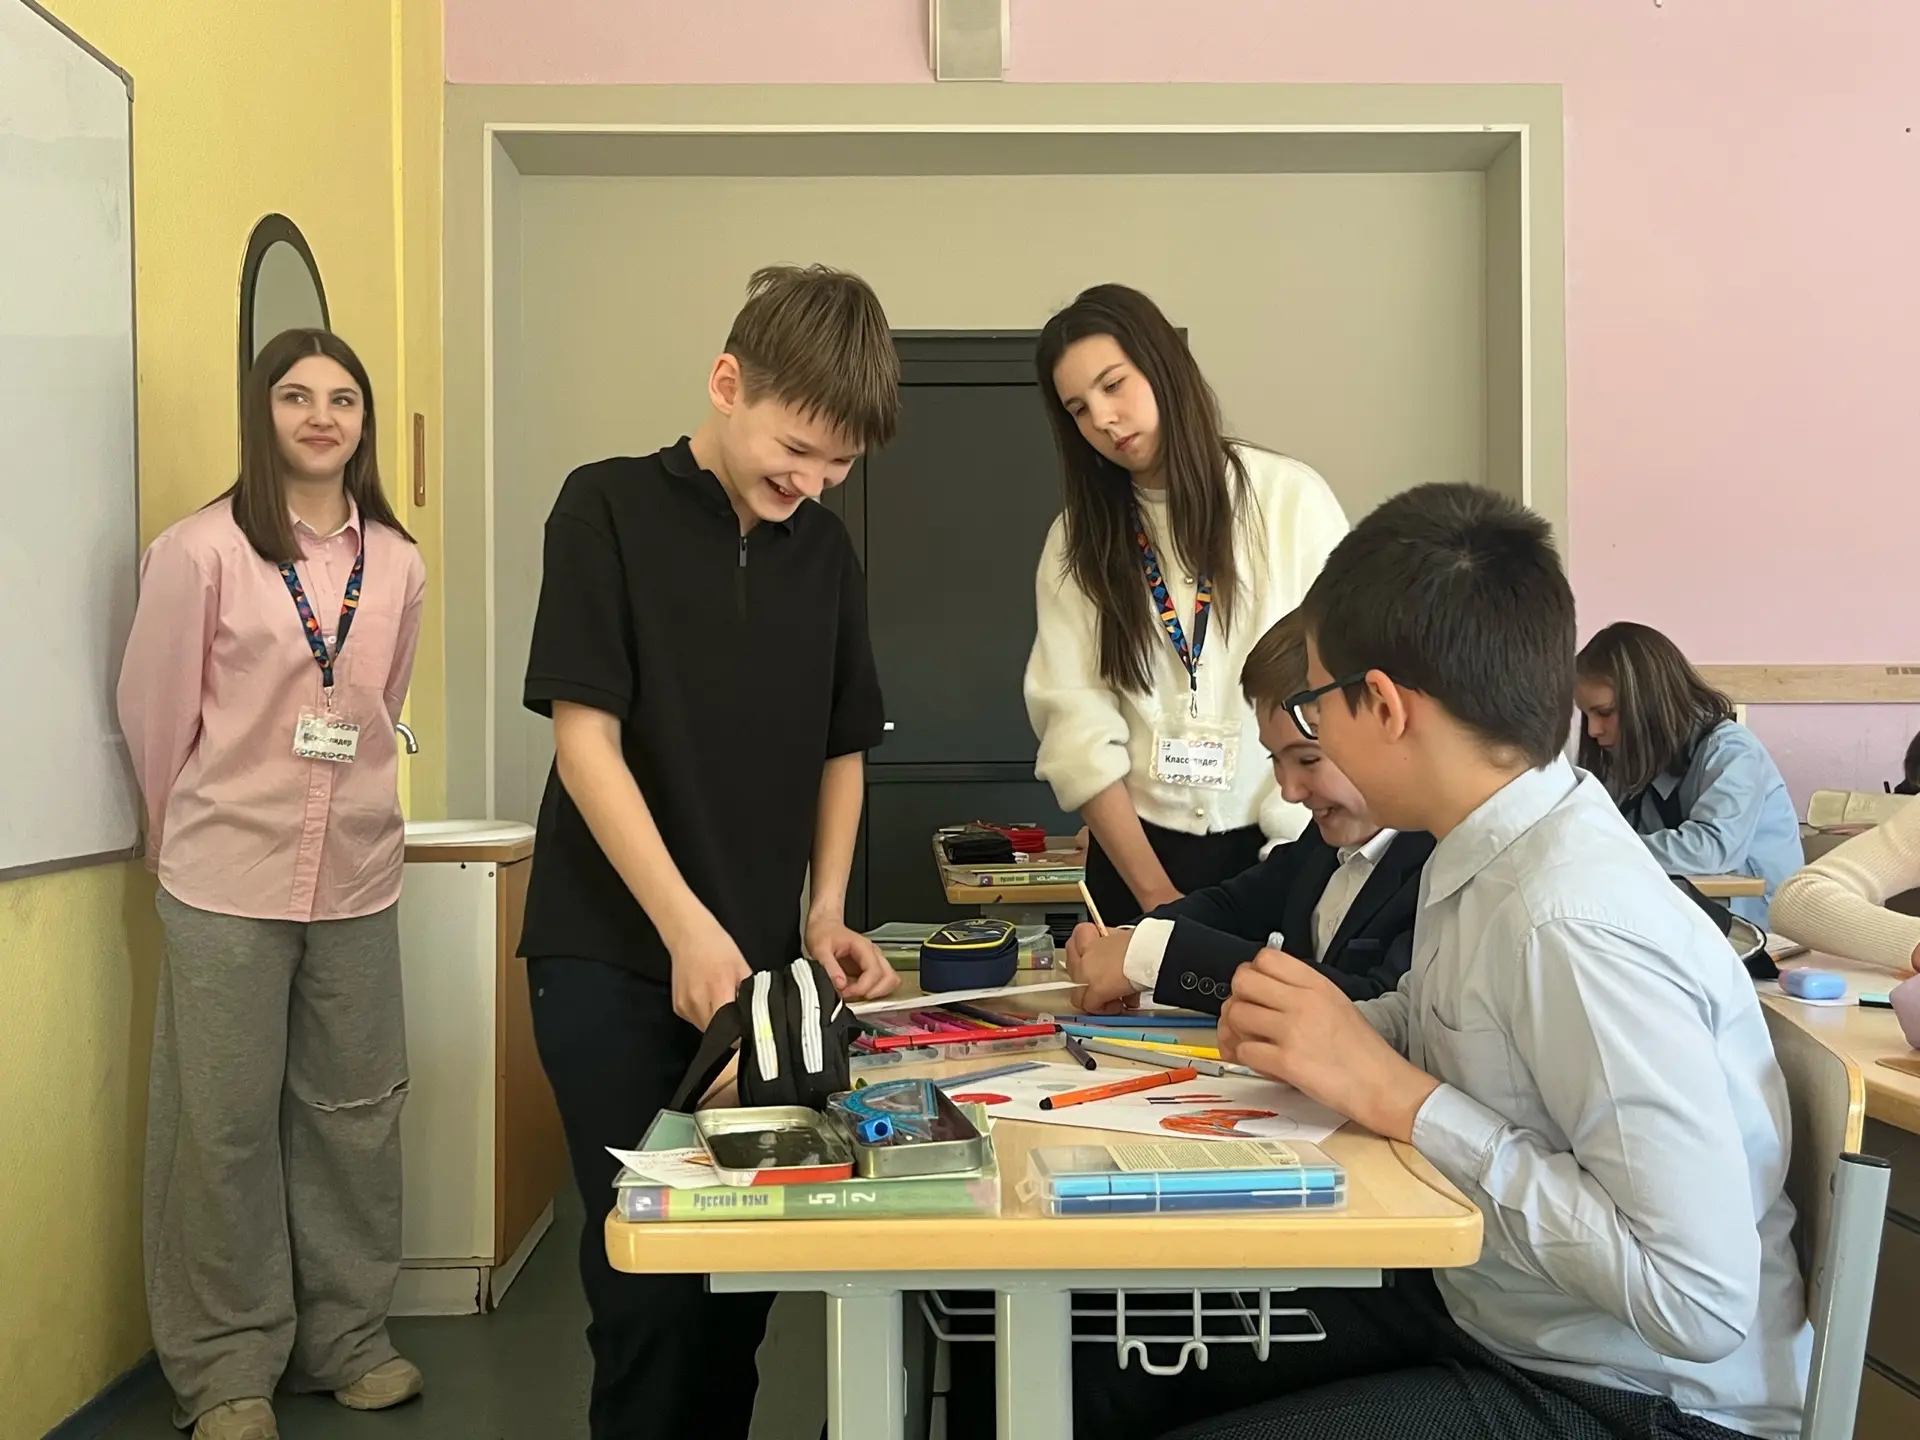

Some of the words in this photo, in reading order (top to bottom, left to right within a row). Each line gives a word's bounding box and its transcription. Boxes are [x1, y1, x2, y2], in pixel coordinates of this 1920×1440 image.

[694, 1192, 737, 1211] Русский
[742, 1193, 769, 1206] язык
[808, 1193, 836, 1205] 5
[851, 1192, 876, 1203] 2
